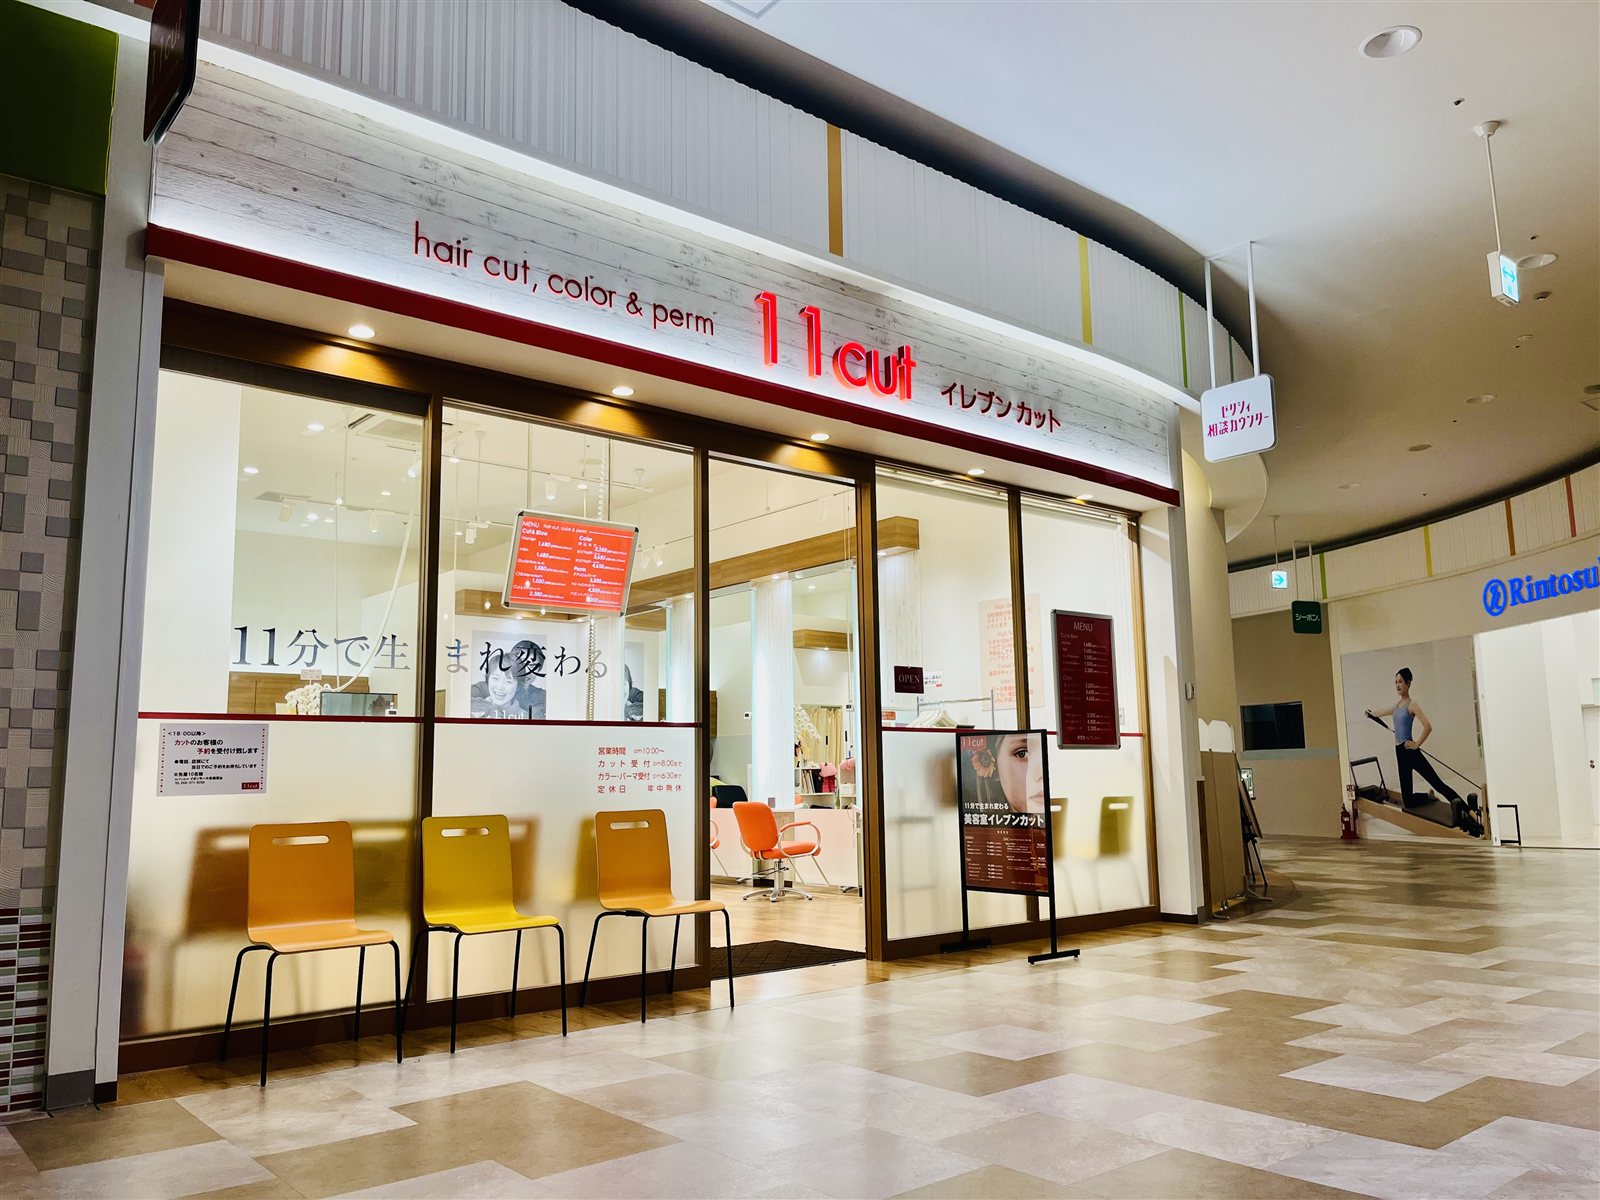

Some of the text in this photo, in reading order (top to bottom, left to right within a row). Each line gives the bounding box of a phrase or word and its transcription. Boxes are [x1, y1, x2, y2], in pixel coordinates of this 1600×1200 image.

[413, 220, 715, 336] hair cut, color & perm
[754, 290, 917, 401] 11cut
[1207, 412, 1269, 437] 相談カウンター
[1073, 621, 1093, 632] MENU
[898, 674, 920, 684] OPEN
[962, 736, 984, 747] 11cut
[598, 747, 626, 755] 営業時間
[597, 785, 626, 793] 定休日
[964, 802, 1009, 811] 11分で生まれ変わる
[964, 813, 1044, 827] 美容室イレブンカット
